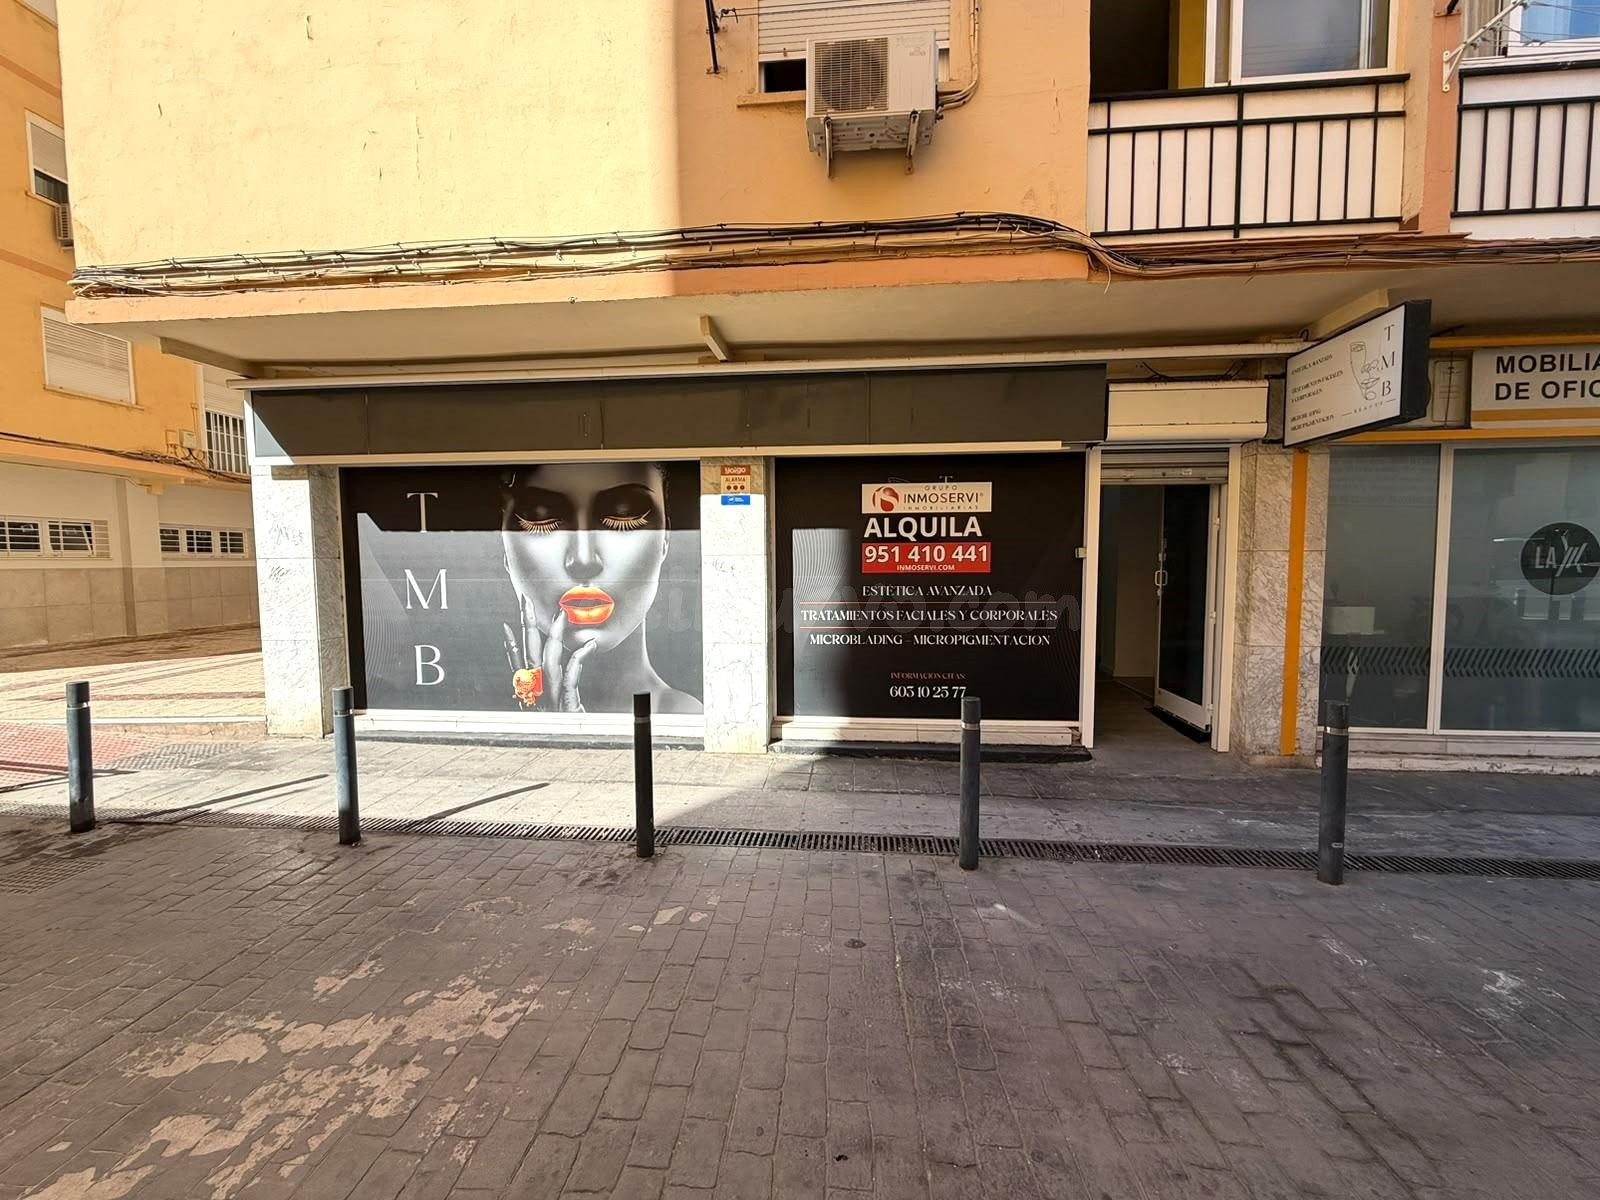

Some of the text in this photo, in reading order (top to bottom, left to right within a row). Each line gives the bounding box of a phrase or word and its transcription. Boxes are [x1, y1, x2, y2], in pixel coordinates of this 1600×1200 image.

[1495, 382, 1530, 400] DE
[904, 492, 979, 504] INMOSERVI
[864, 516, 983, 541] ALQUILA
[865, 545, 988, 563] 951 410 441
[926, 585, 993, 596] AVANZADA
[801, 609, 1058, 621] TRATAMIENTOS FACIALES Y CORPORALES
[809, 634, 903, 645] MICROBLADING
[918, 685, 930, 698] 10
